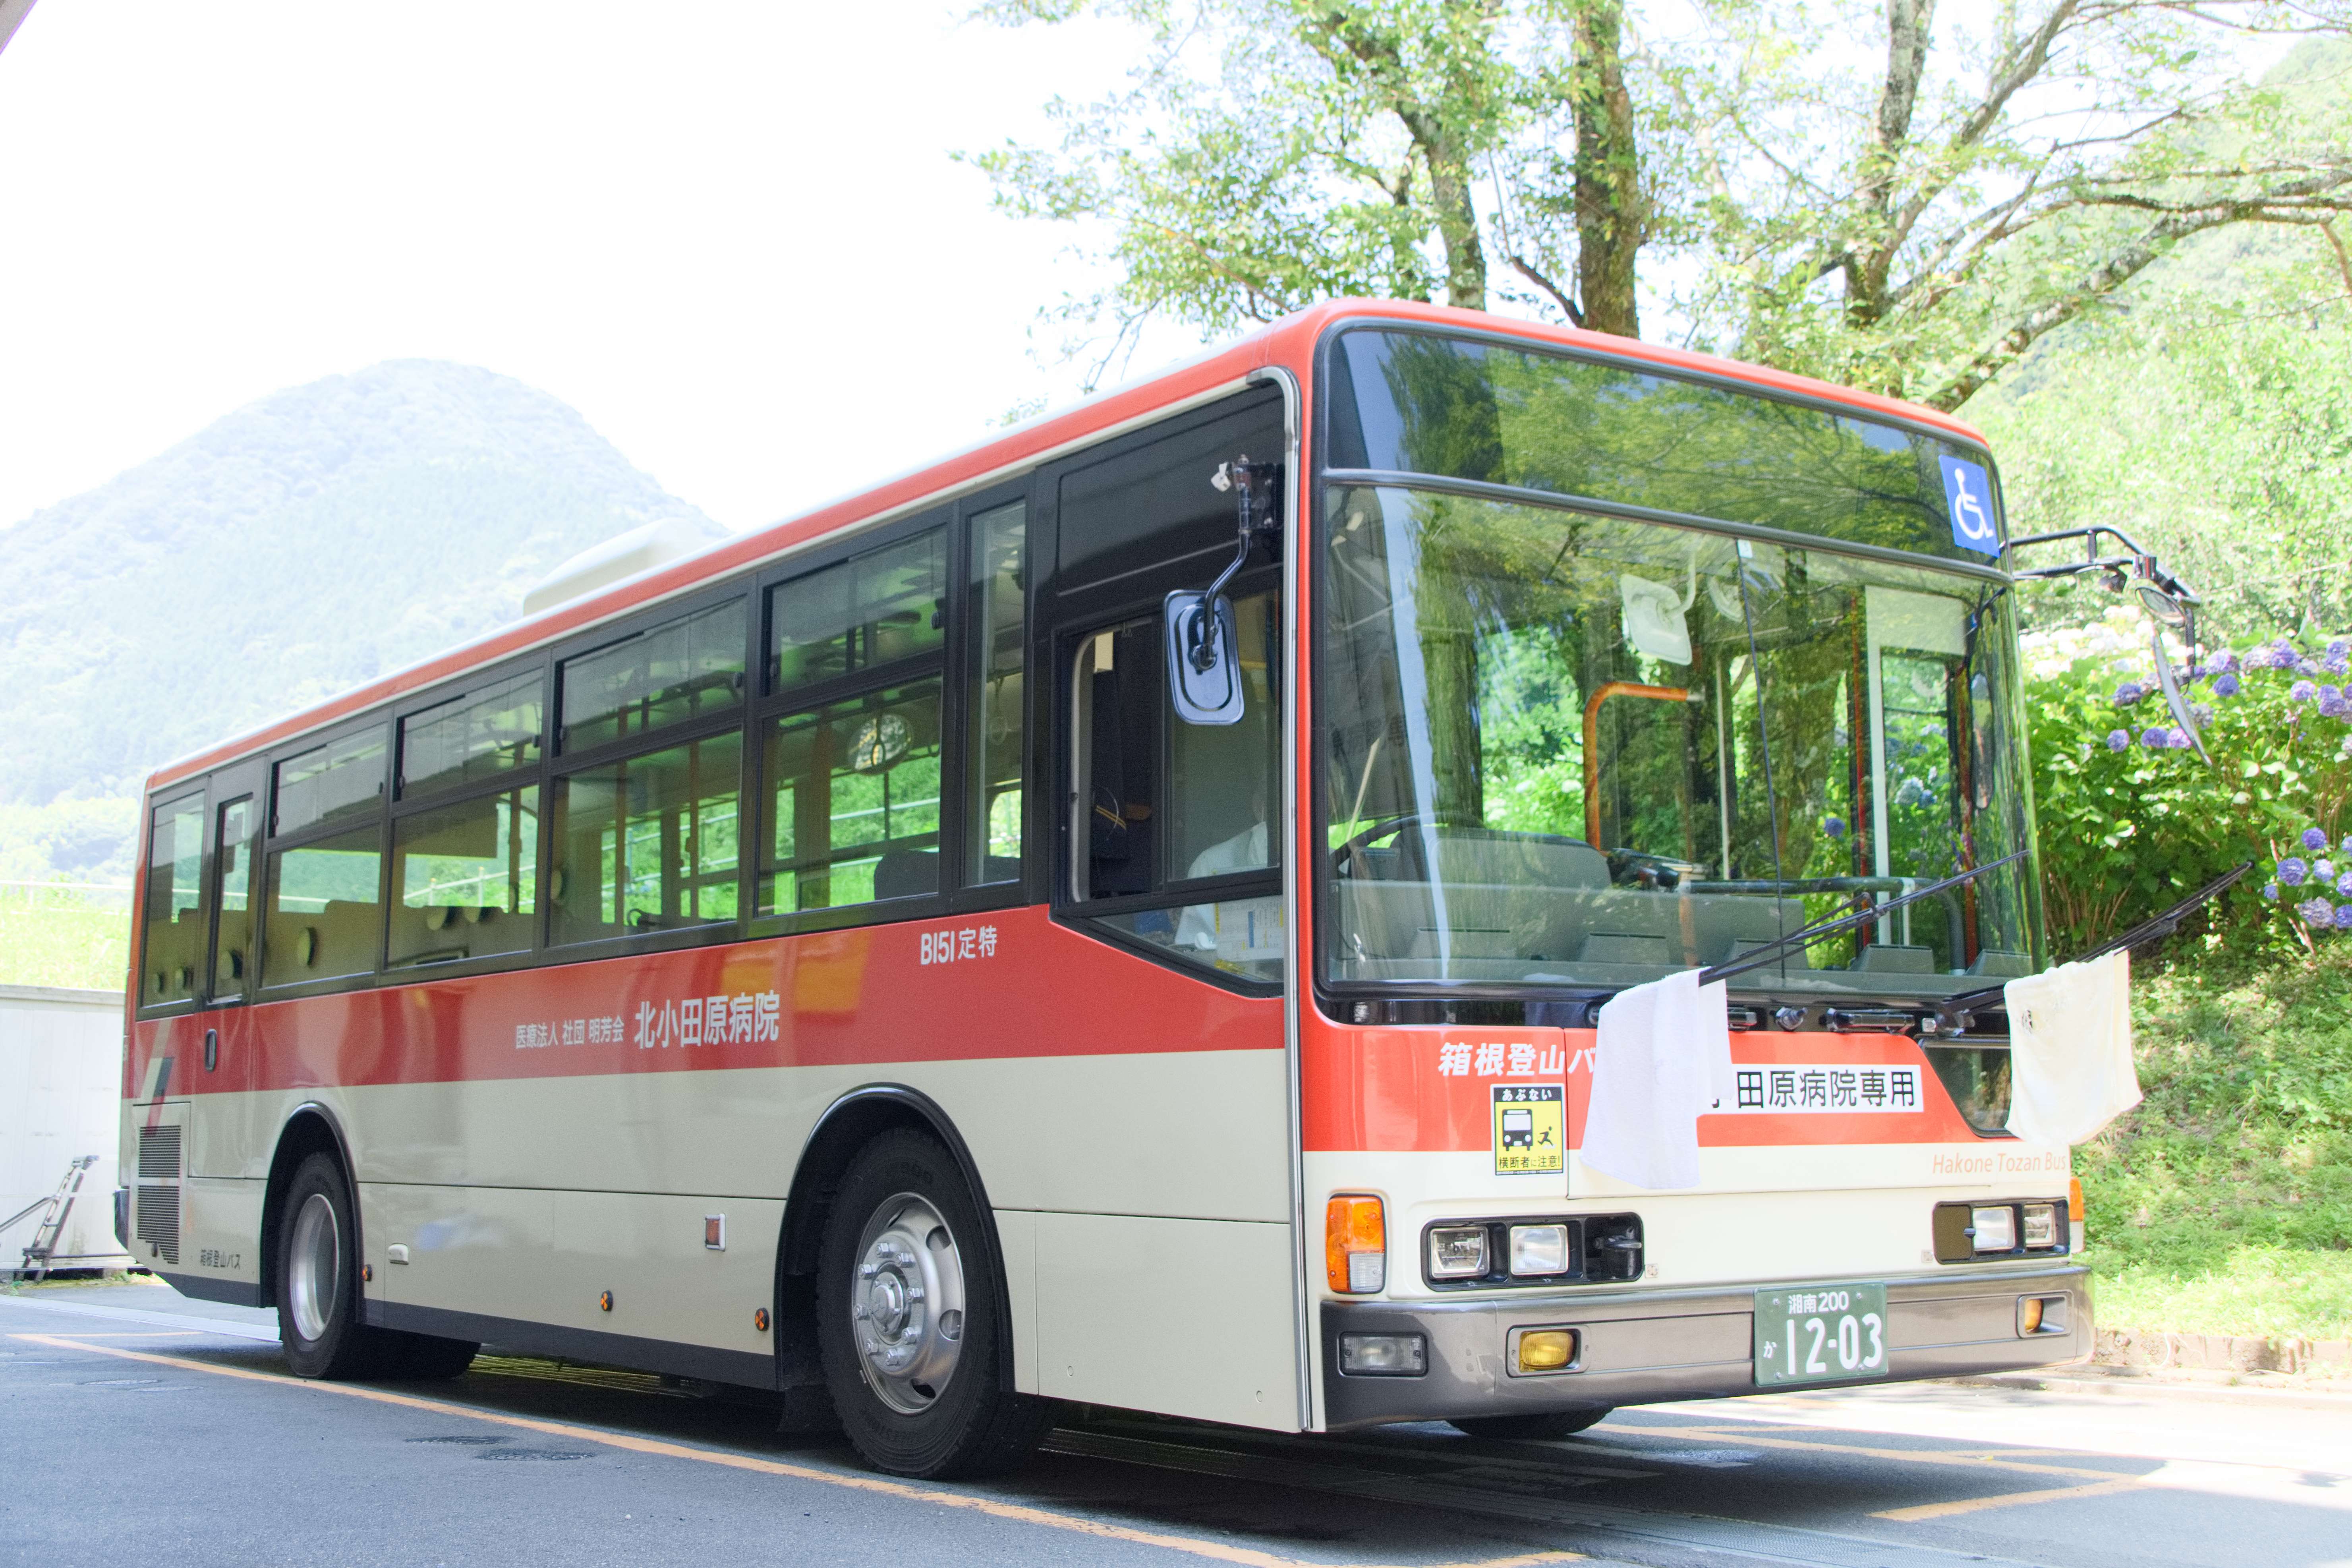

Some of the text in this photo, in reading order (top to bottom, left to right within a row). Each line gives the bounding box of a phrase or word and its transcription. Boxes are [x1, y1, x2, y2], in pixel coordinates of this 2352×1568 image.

[516, 989, 780, 1049] 医療法人 社団 明芳会 北小田原病院
[1502, 1088, 1552, 1102] あぶない
[1711, 1069, 1915, 1109] 田原病院専用
[1499, 1155, 1560, 1169] 横断者に注意!
[1932, 1151, 2066, 1174] Hakone Tozan Bus
[1788, 1291, 1850, 1314] 湘南200
[1786, 1313, 1883, 1375] 12-03
